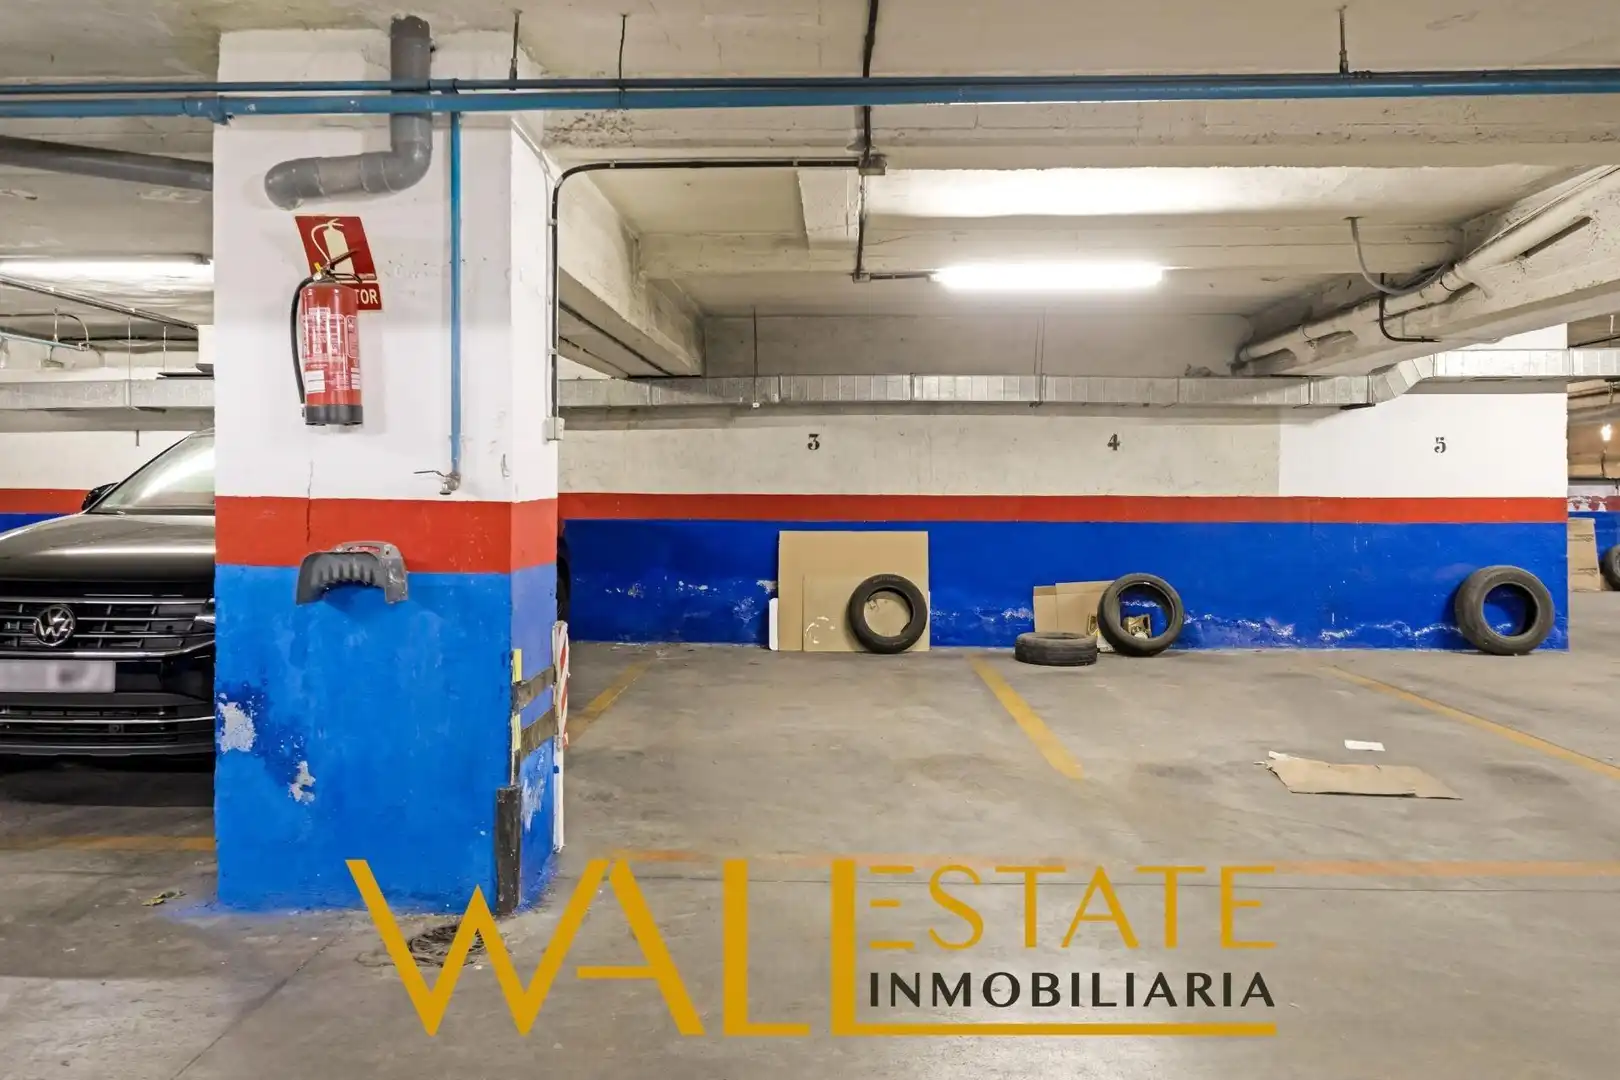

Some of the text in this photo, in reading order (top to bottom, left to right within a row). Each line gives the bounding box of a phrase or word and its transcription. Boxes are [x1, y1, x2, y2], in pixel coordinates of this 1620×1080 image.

[807, 433, 821, 451] 3
[1107, 433, 1121, 451] 4
[1433, 436, 1447, 454] 5
